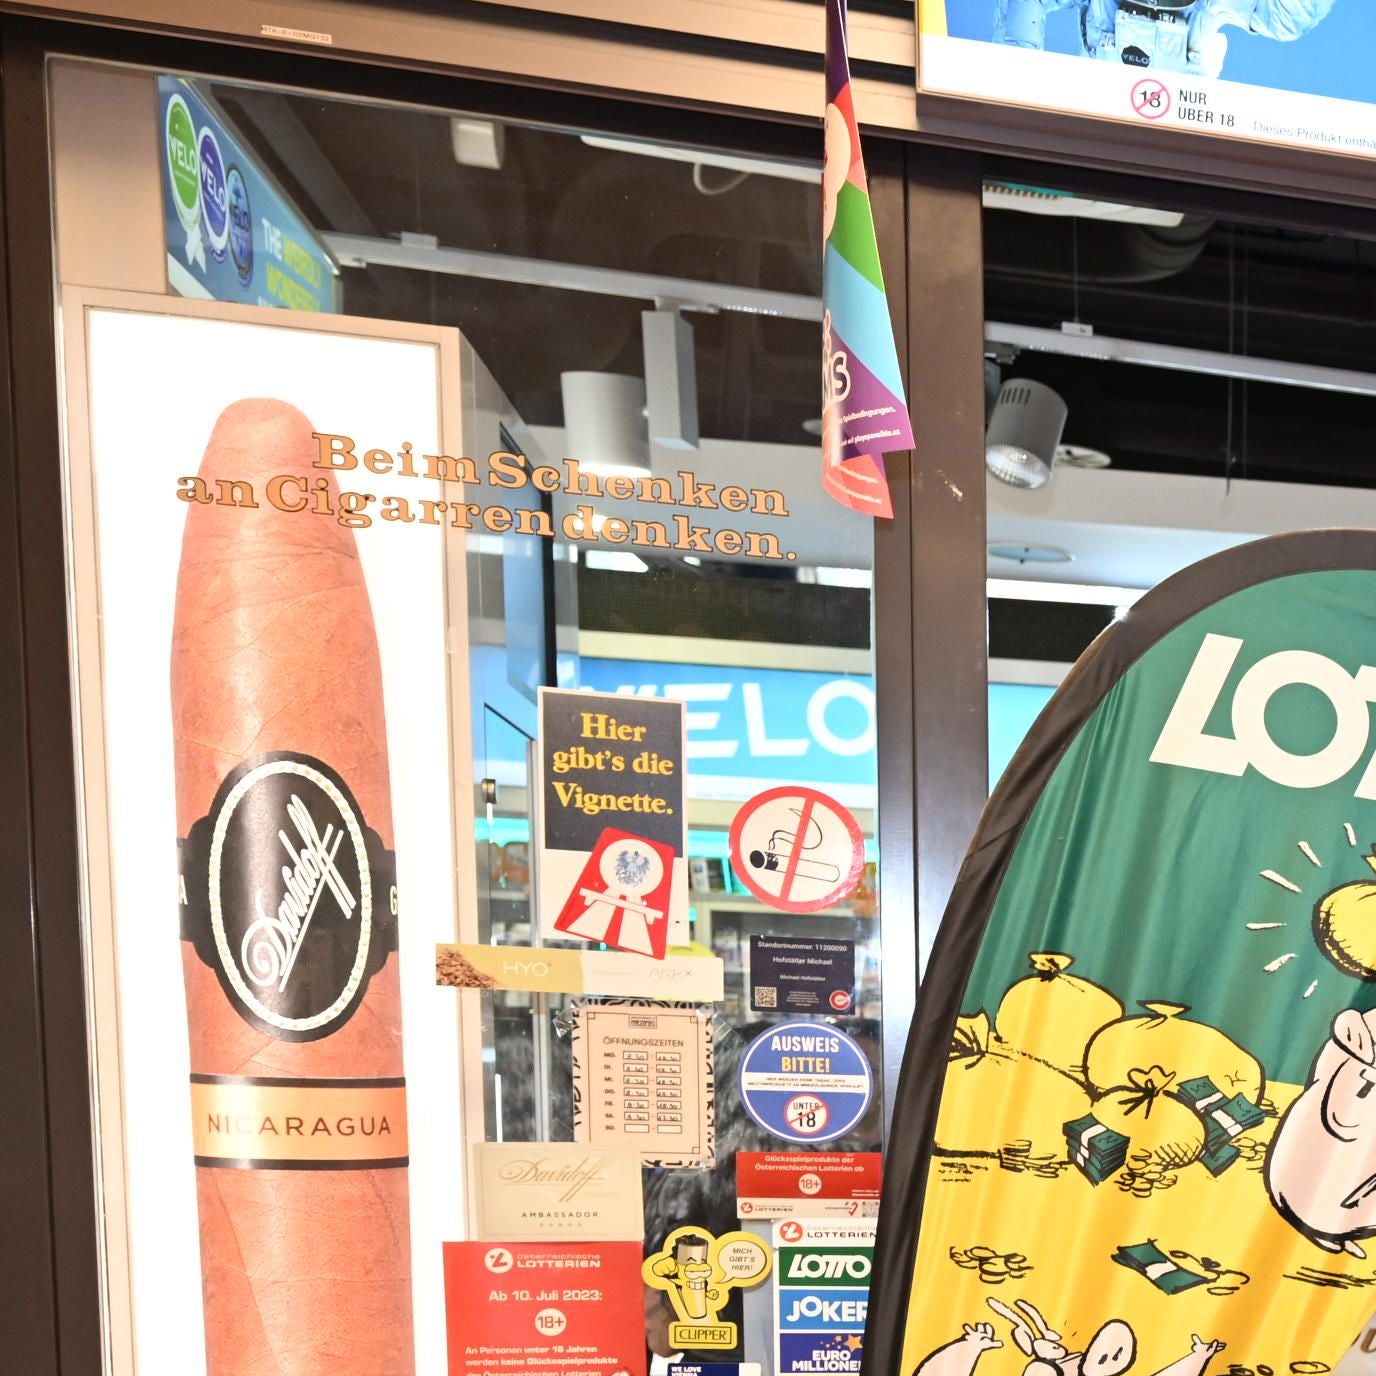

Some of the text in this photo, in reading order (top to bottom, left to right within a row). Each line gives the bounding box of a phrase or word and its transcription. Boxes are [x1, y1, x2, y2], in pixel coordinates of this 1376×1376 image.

[1178, 89, 1207, 105] NUR
[1177, 105, 1236, 127] ÜBER 18
[1253, 120, 1294, 138] Dieses
[1296, 128, 1342, 145] Produkt
[312, 431, 482, 485] Beim
[488, 452, 790, 518] Schenken
[176, 474, 797, 561] an Cigarren denken.
[580, 711, 647, 742] Hier
[552, 746, 675, 776] gibt's die
[552, 781, 675, 815] Vignette.
[503, 960, 548, 977] HYO
[602, 1035, 684, 1048] ÖFFNUNGSZEITEN
[771, 1035, 840, 1053] AUSWEIS
[781, 1056, 830, 1073] BITTE!
[793, 1102, 820, 1111] UNTER
[207, 1113, 392, 1138] NICARAGUA
[797, 1111, 816, 1128] 18
[764, 1154, 855, 1164] Glücksspielprodukte der
[800, 1178, 820, 1190] 18+
[807, 1231, 877, 1239] LOTTERIEN
[516, 1260, 601, 1268] LOTTERIEN
[787, 1253, 872, 1279] LOTTO
[488, 1289, 603, 1302] Ab 10. Juli 2023:
[537, 1315, 565, 1329] 18+
[679, 1329, 728, 1341] CLIPPER
[465, 1346, 478, 1354] An
[479, 1346, 523, 1354] Personen
[524, 1346, 550, 1354] unter
[565, 1345, 598, 1353] Jahren
[812, 1349, 851, 1361] EURO
[465, 1356, 618, 1367] werden keine Glücksspielprodukte
[792, 1360, 861, 1372] MILLIONE
